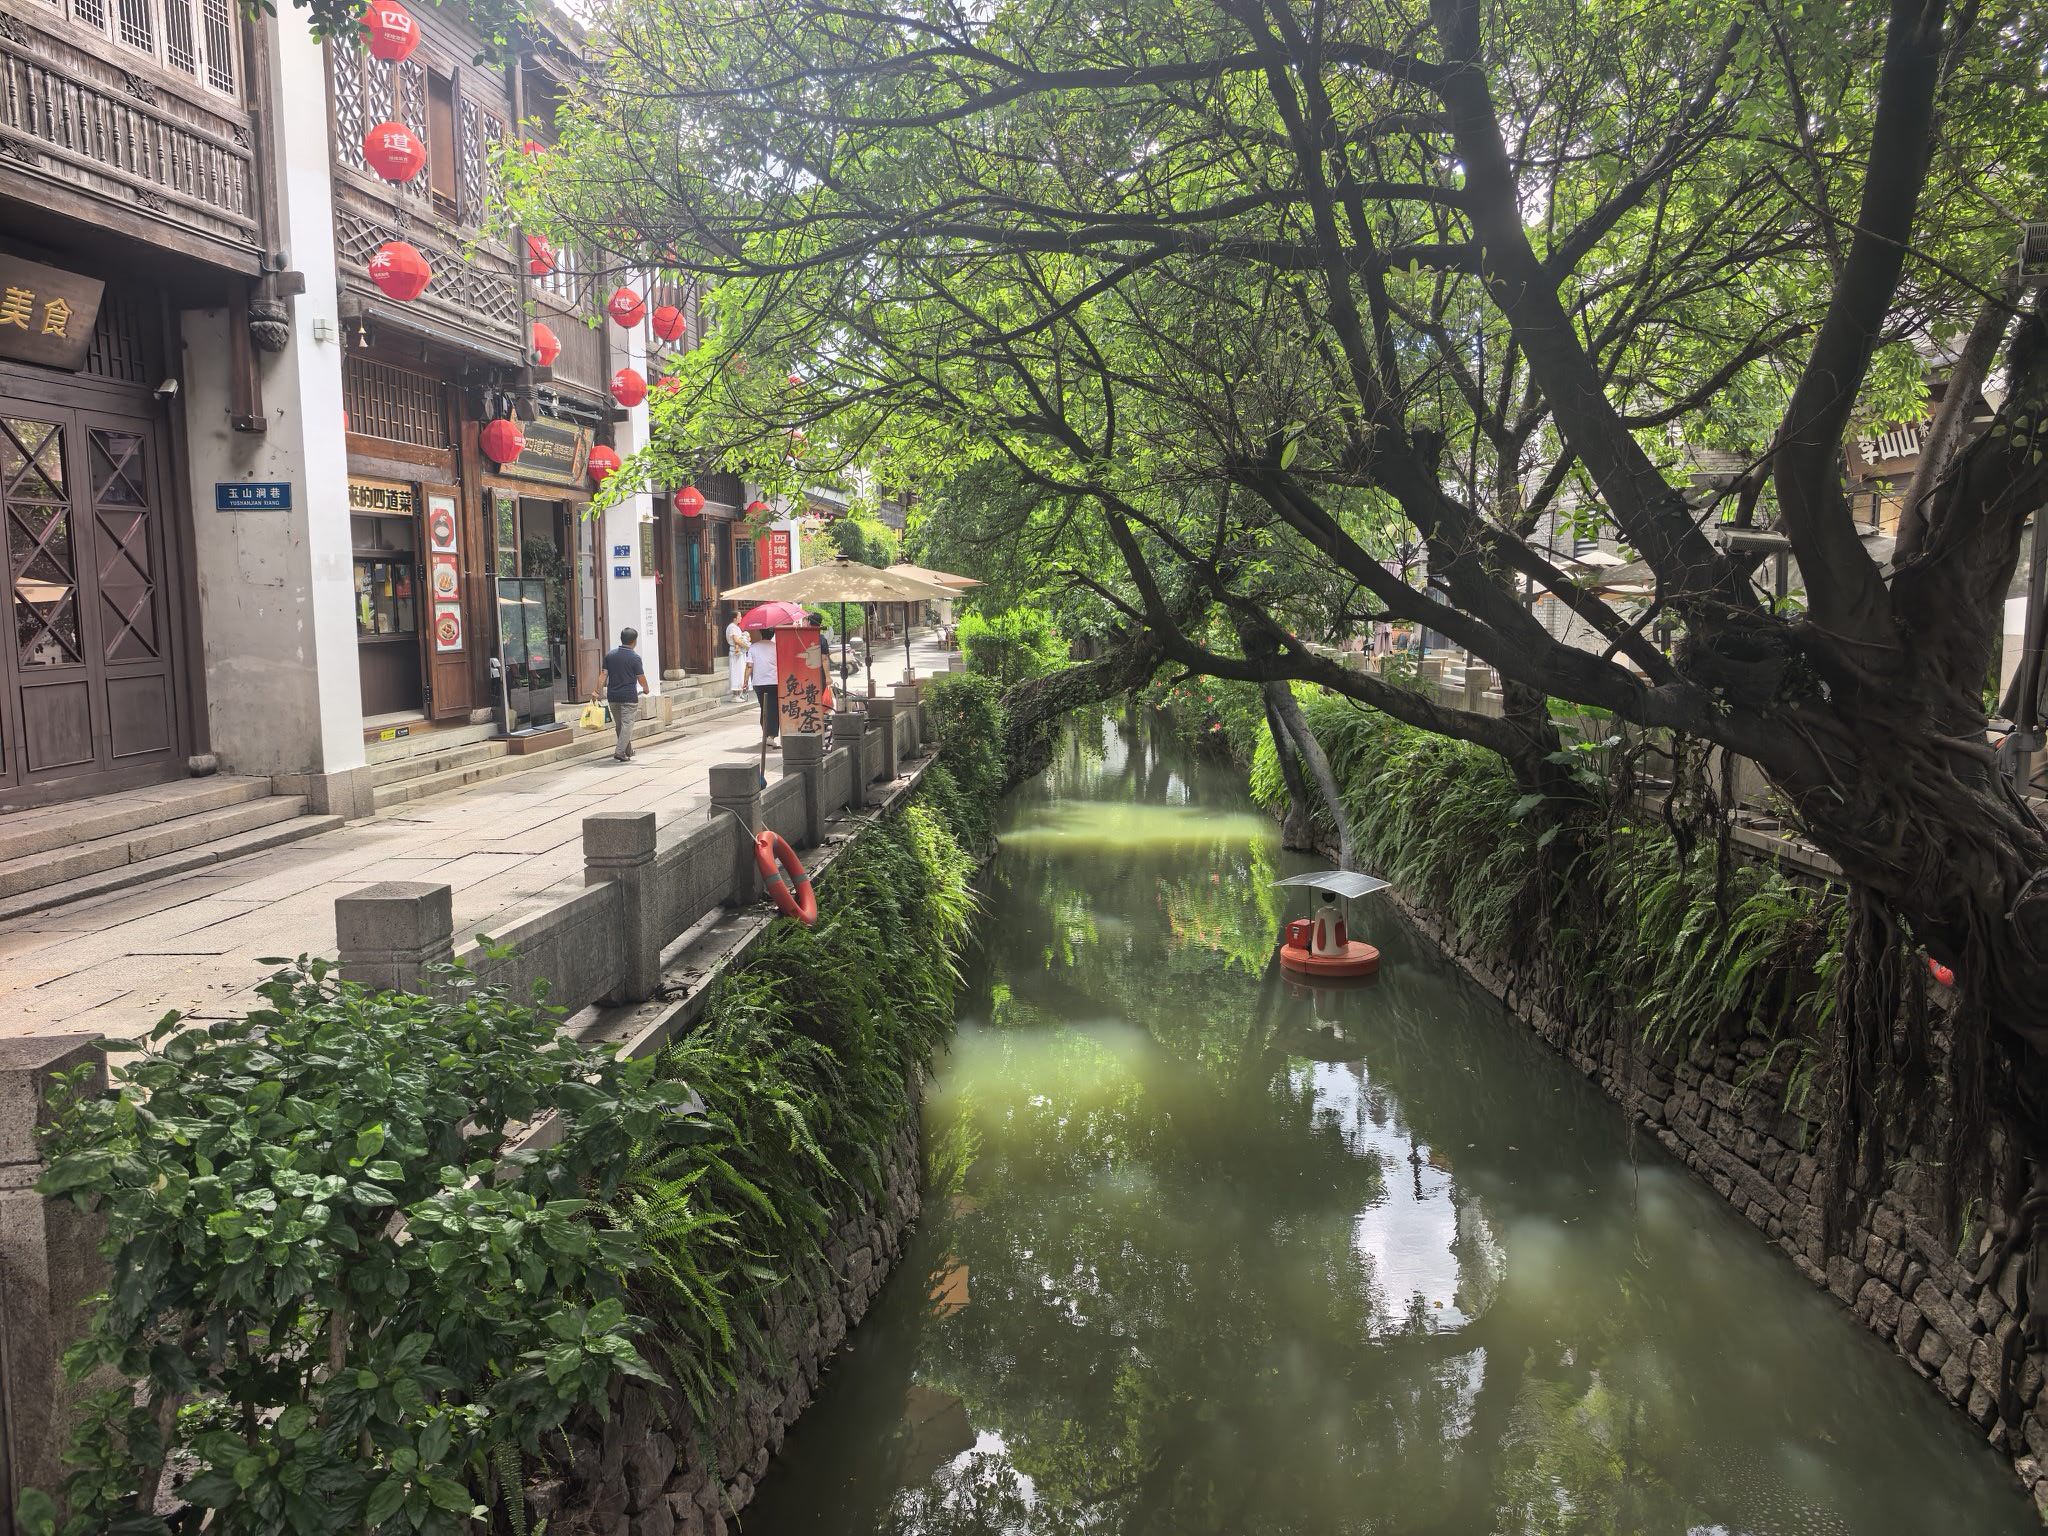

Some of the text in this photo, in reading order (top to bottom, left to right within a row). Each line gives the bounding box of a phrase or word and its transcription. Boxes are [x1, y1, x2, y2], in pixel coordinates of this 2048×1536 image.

[381, 10, 411, 34] 四
[383, 133, 412, 153] 道
[0, 286, 74, 339] 美食
[228, 487, 281, 499] 玉山涧巷
[773, 534, 788, 569] 四道菜
